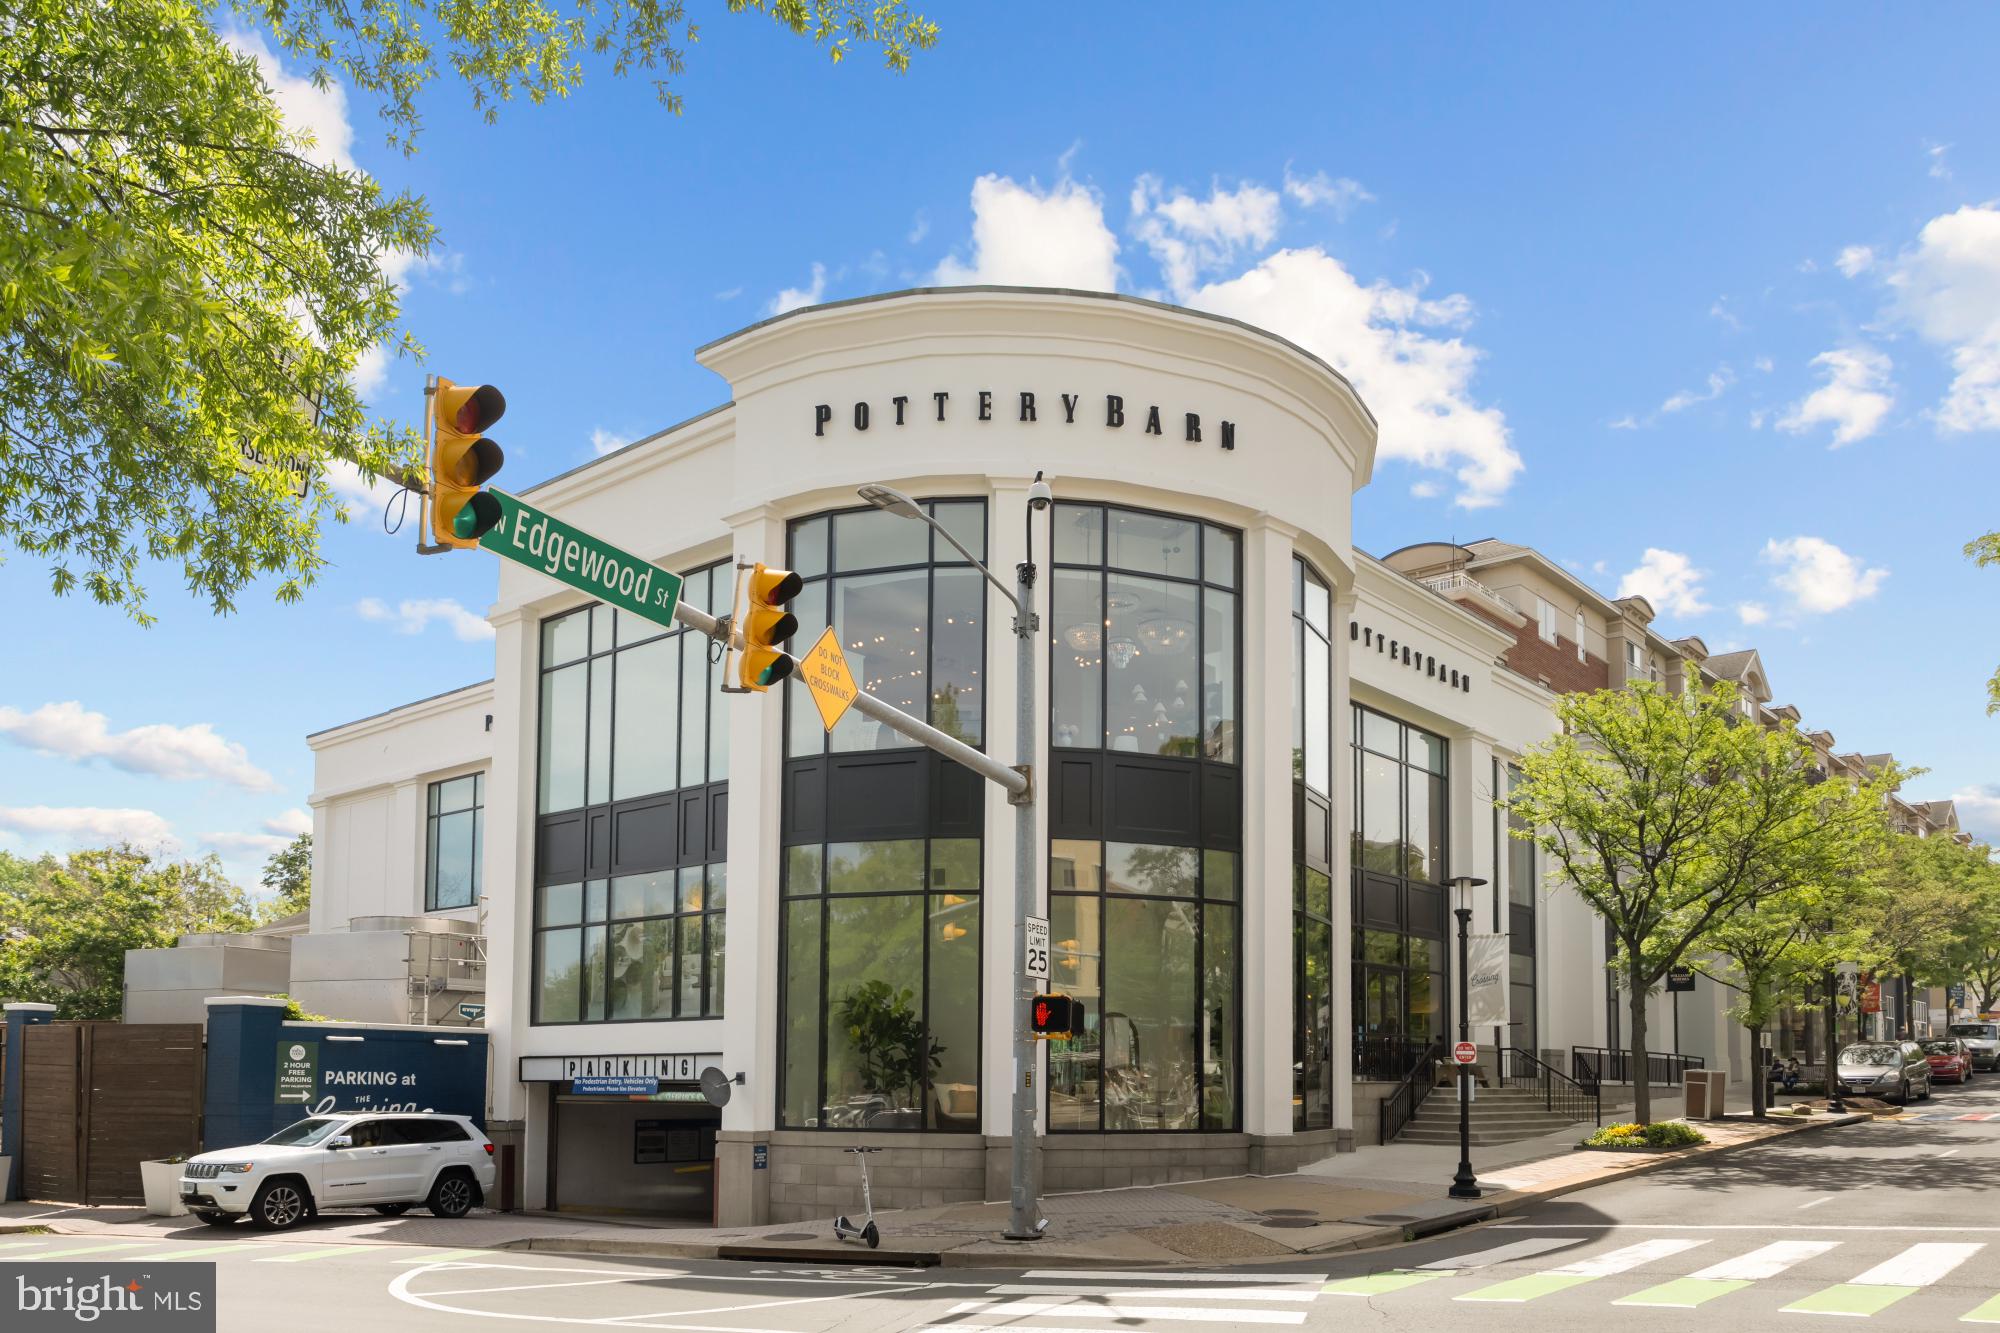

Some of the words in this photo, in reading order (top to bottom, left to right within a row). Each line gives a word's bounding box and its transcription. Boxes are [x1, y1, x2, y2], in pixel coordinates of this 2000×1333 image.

[494, 514, 507, 535] N
[512, 508, 653, 604] Edgewood
[818, 646, 828, 659] DO
[830, 651, 843, 667] NOT
[820, 663, 840, 681] BLOCK
[810, 675, 850, 702] CROSSWALKS
[1027, 922, 1048, 936] SPEED
[1029, 935, 1046, 947] LIMIT
[1027, 948, 1047, 973] 25
[569, 1059, 688, 1077] PARKING
[325, 1071, 398, 1086] PARKING
[401, 1073, 417, 1086] at
[644, 1077, 658, 1086] Only
[354, 1095, 371, 1104] THE
